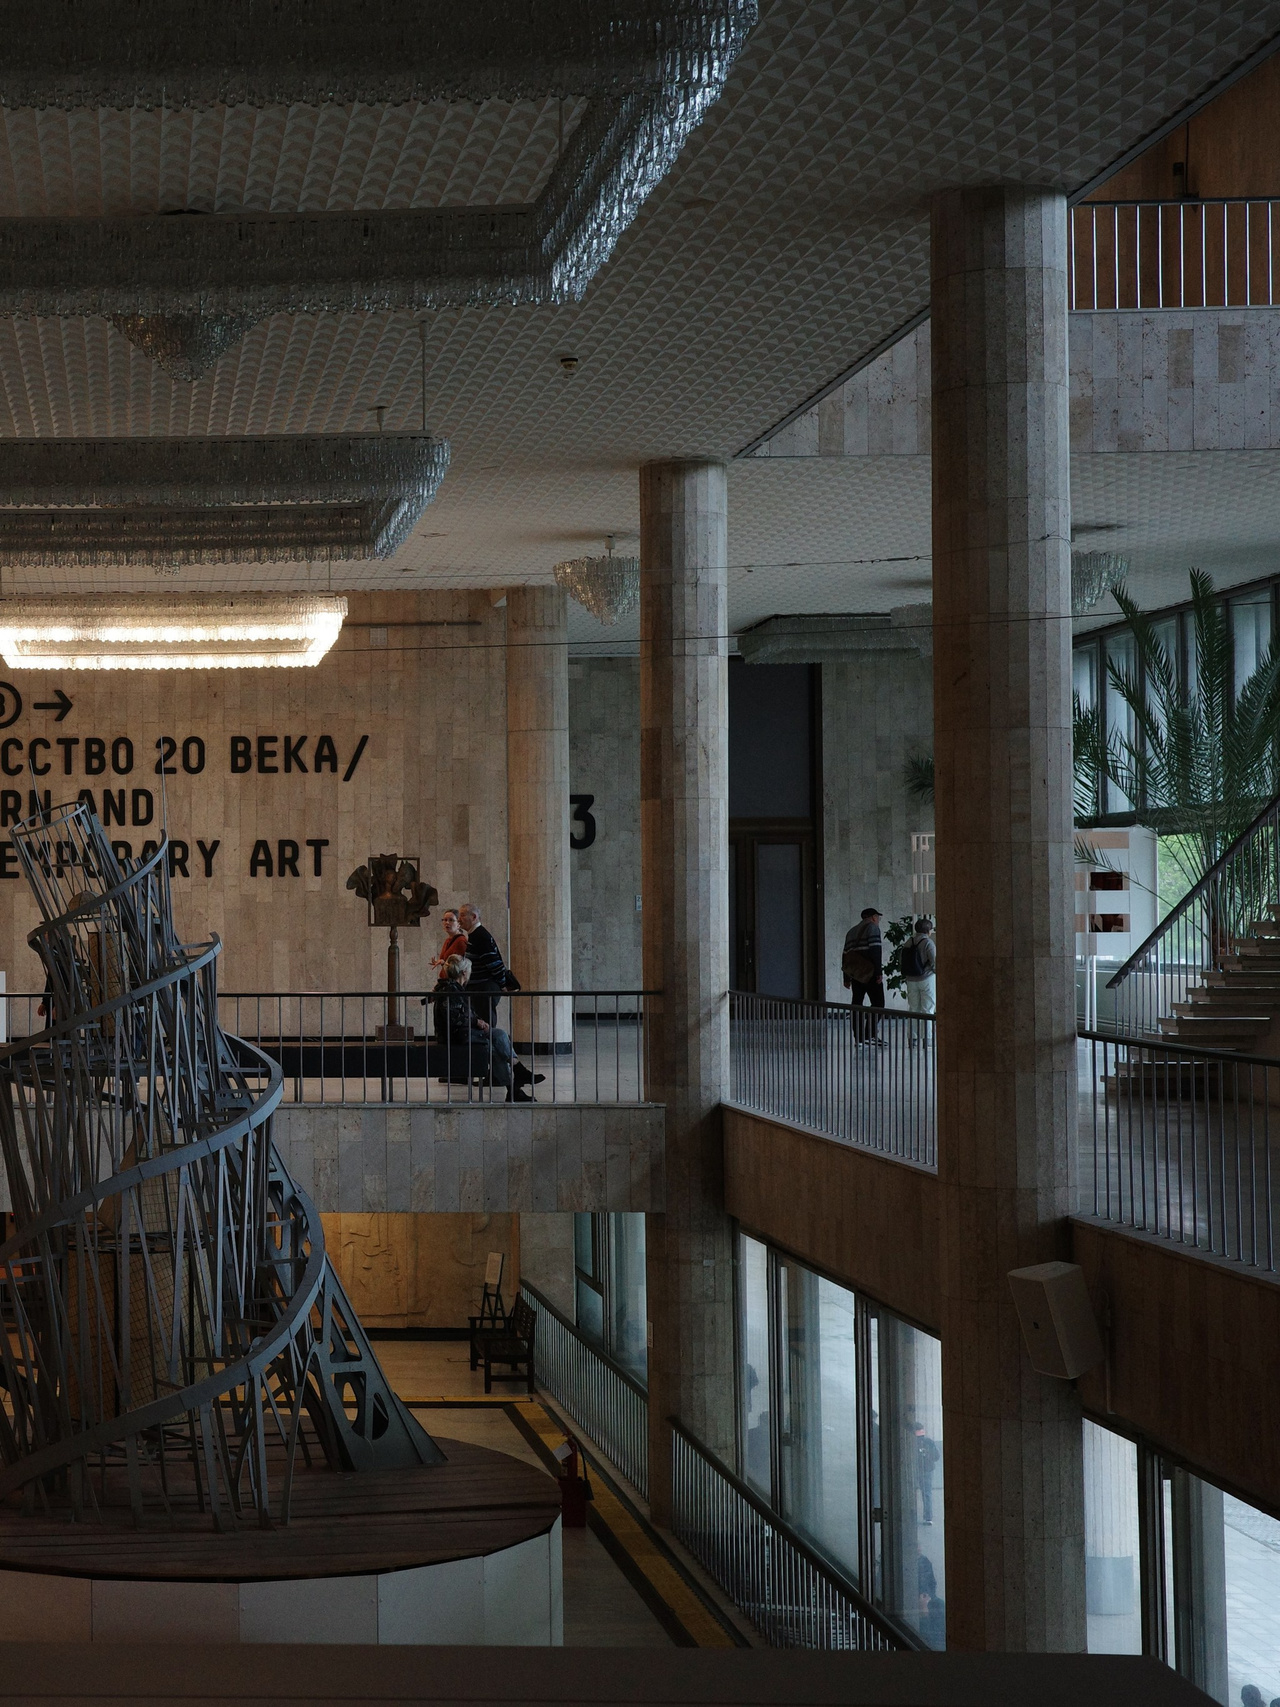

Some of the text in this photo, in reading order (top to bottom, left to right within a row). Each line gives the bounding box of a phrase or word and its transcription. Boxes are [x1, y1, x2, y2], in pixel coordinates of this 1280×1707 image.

[155, 736, 205, 774] 20
[76, 788, 154, 827] AND
[251, 839, 329, 878] ART
